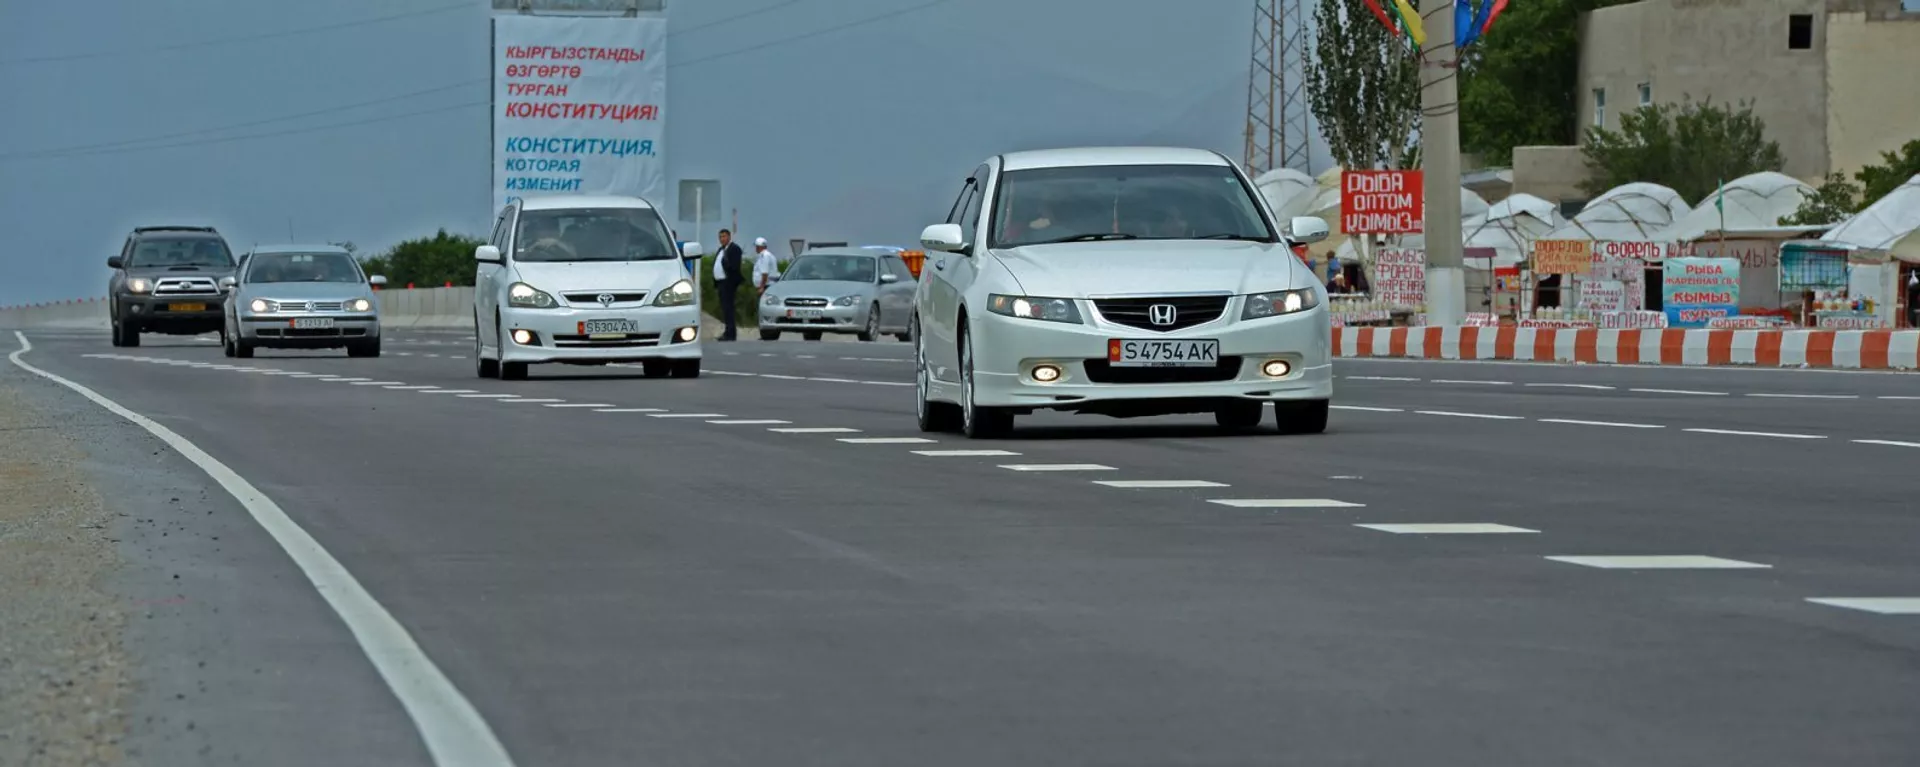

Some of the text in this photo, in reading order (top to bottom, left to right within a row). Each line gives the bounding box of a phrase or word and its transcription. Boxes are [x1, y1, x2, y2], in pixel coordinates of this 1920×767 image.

[506, 46, 645, 63] КЫРГЫЗСТАНДЫ
[506, 65, 581, 79] ӨЗГӨРТӨ
[506, 84, 568, 97] ТУРГАН
[505, 103, 658, 123] КОНСТИТУЦИЯ!
[505, 137, 656, 158] КОНСТИТУЦИЯ,
[505, 159, 580, 172] КОТОРАЯ
[506, 178, 583, 191] ИЗМЕНИТ
[1347, 173, 1404, 193] РЫБА
[1353, 193, 1412, 211] ОПТОМ
[1346, 211, 1412, 232] КЫМЫЗ
[1377, 248, 1425, 264] КЫМЫЗ
[1685, 264, 1723, 274] РЫБА
[1673, 292, 1732, 303] КЫМЫЗ
